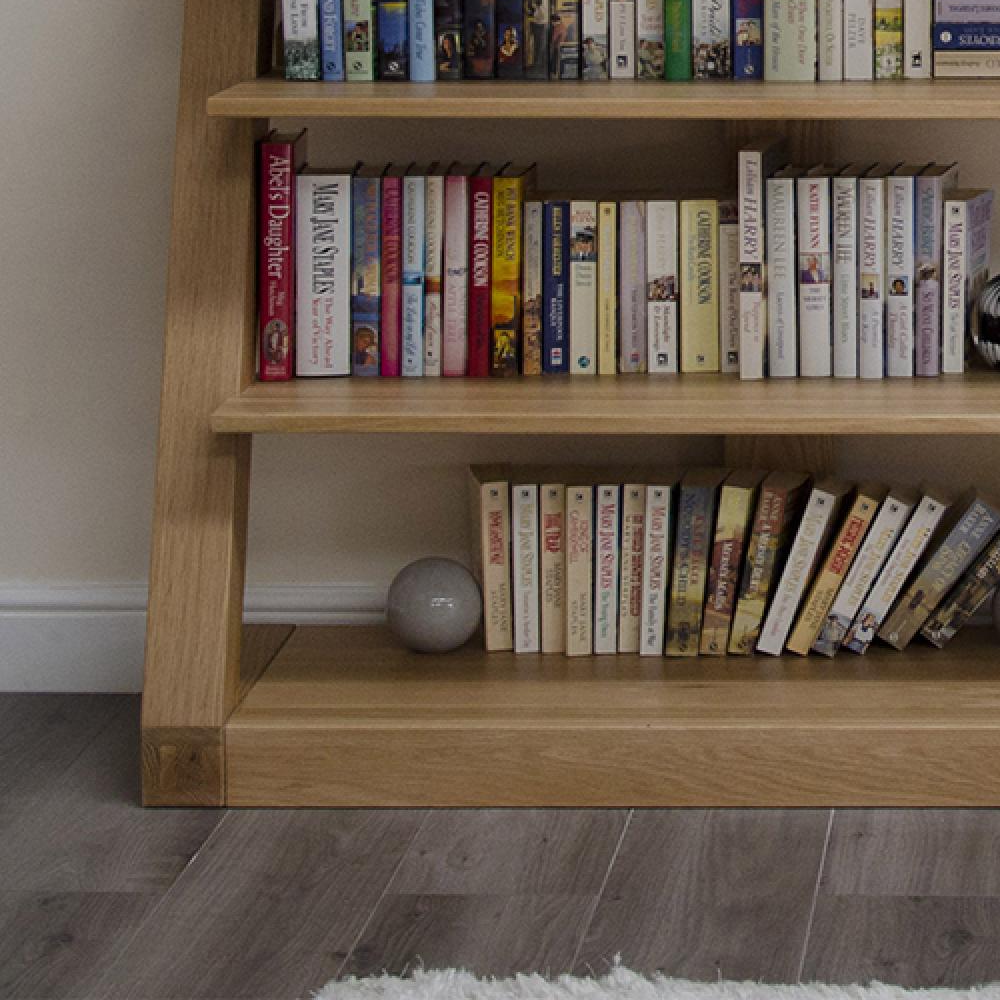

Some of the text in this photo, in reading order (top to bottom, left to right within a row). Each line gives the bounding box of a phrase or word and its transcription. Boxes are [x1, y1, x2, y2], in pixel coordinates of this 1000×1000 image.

[264, 155, 291, 280] Abel's Daughter
[309, 183, 339, 295] MARY JANE STAPLES
[474, 192, 488, 241] CATHERINE
[505, 205, 517, 227] BANK
[745, 159, 758, 259] Lilian HARRY
[773, 184, 787, 279] MAUREEN LEE
[809, 183, 820, 249] KATIE FLYNN
[836, 185, 853, 265] MAUREEN LEE
[864, 218, 876, 270] HARRY
[893, 217, 905, 269] HARRY
[474, 243, 488, 287] COOKSON
[697, 210, 712, 305] CATHERINE COOKSON
[948, 222, 963, 309] MARY JANE STAPLES
[309, 330, 321, 366] Victory
[311, 319, 321, 329] of
[323, 297, 334, 370] The Way Ahead
[600, 504, 615, 589] MARY JANE STAPLES
[651, 507, 666, 591] MARY JANE STAPLES
